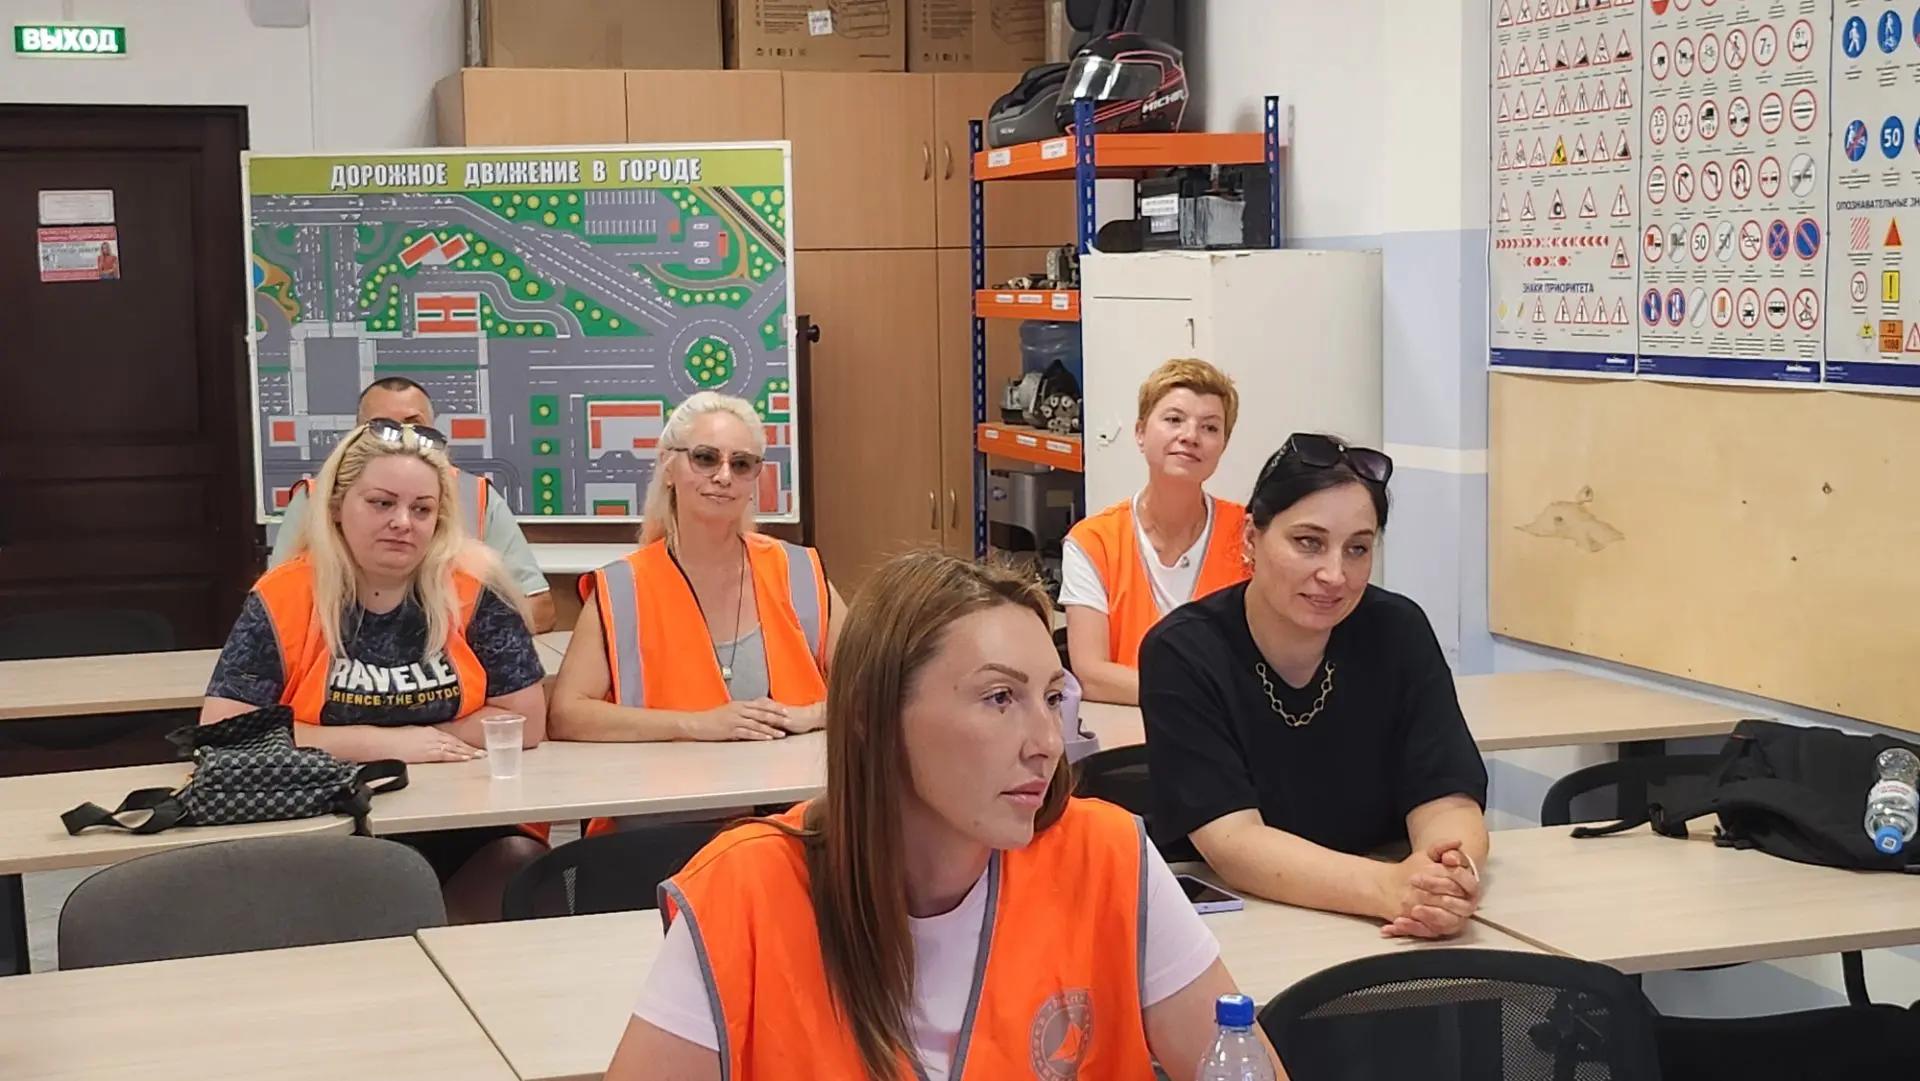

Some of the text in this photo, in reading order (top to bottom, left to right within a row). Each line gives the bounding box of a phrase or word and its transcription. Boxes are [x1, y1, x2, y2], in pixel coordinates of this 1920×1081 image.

[22, 28, 119, 53] ВЫХОД
[1883, 128, 1901, 148] 50
[331, 157, 702, 190] ДОРОЖНОЕ ДВИЖЕНИЕ В ГОРОДЕ
[1835, 199, 1907, 211] ОПОЗНАВАТЕЛЬНЫЕ
[1694, 234, 1707, 251] 50
[1523, 282, 1595, 294] ЗНАКИ ПРИОРИТЕТА
[1854, 280, 1865, 295] 70
[330, 653, 457, 692] RAVELE
[332, 686, 460, 706] RIENCE THE OUTDO
